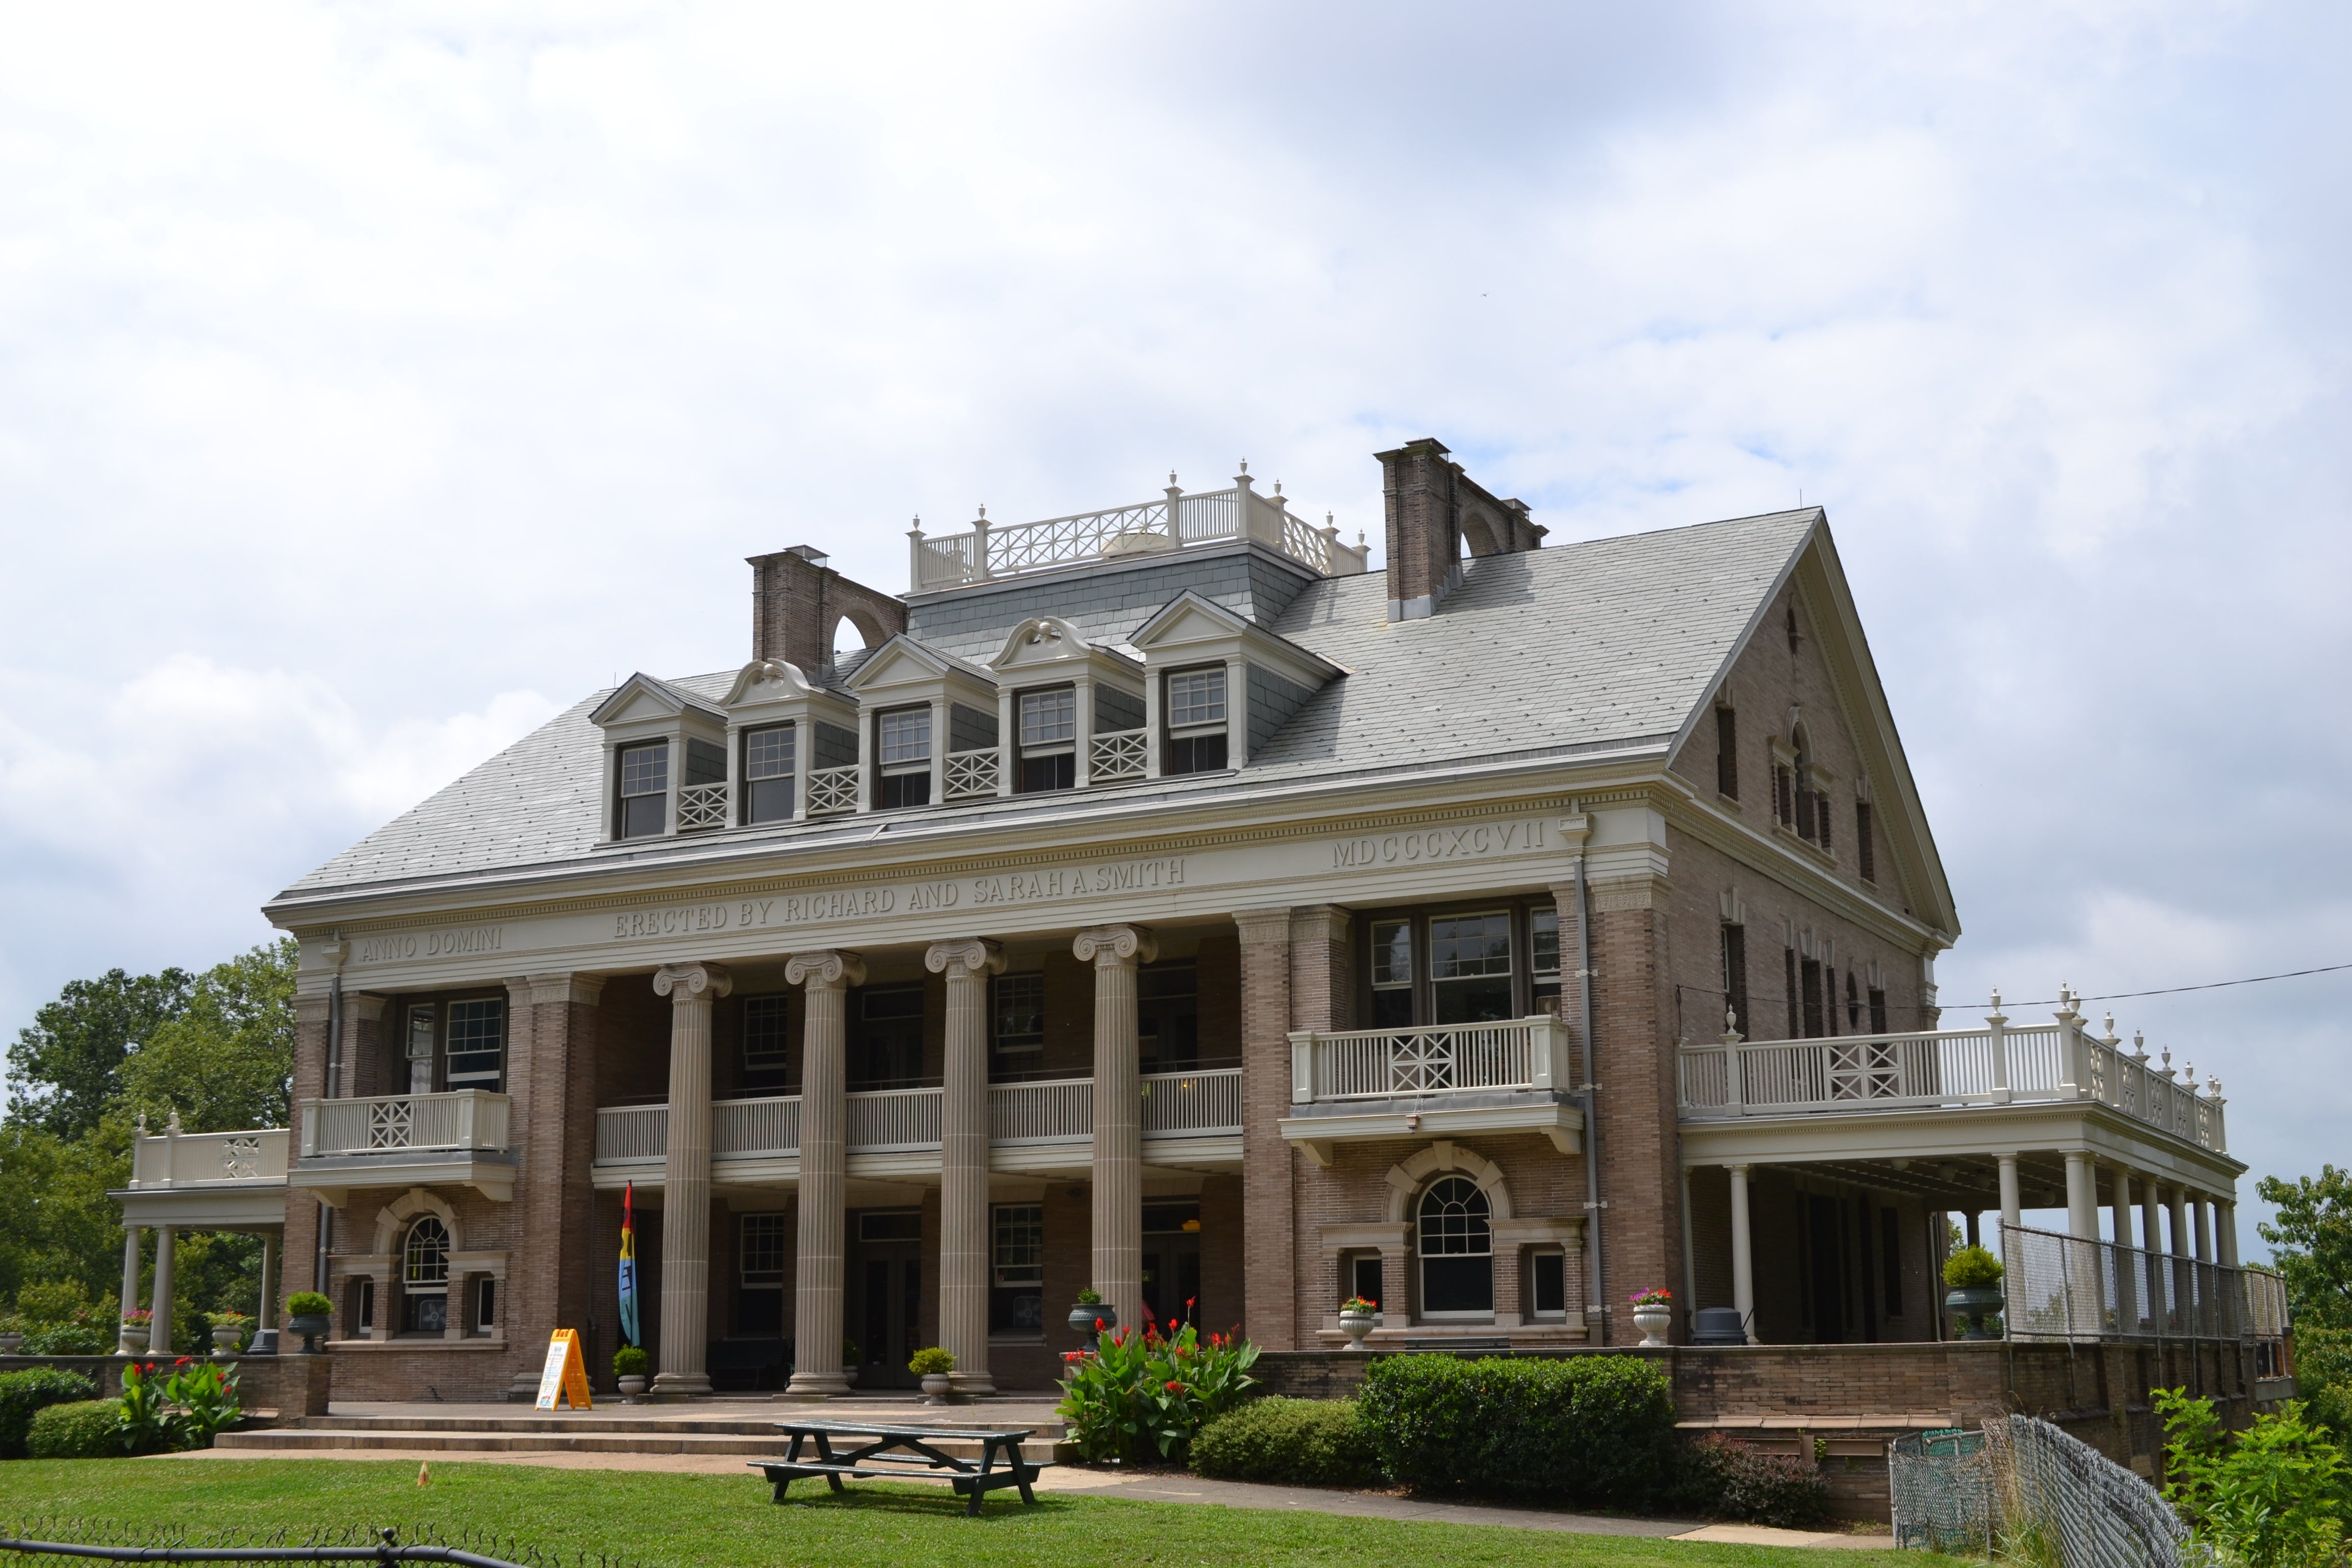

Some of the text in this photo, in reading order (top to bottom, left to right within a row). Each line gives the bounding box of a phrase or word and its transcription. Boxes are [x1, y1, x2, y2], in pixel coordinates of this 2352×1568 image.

[1333, 821, 1544, 867] MDCCCXCVII
[615, 906, 727, 937] ERECTED
[740, 901, 773, 925] BY
[786, 889, 895, 921] RICHARD
[909, 883, 958, 909] AND
[974, 872, 1063, 902] SARAH
[361, 928, 502, 961] ANNO DOMINI
